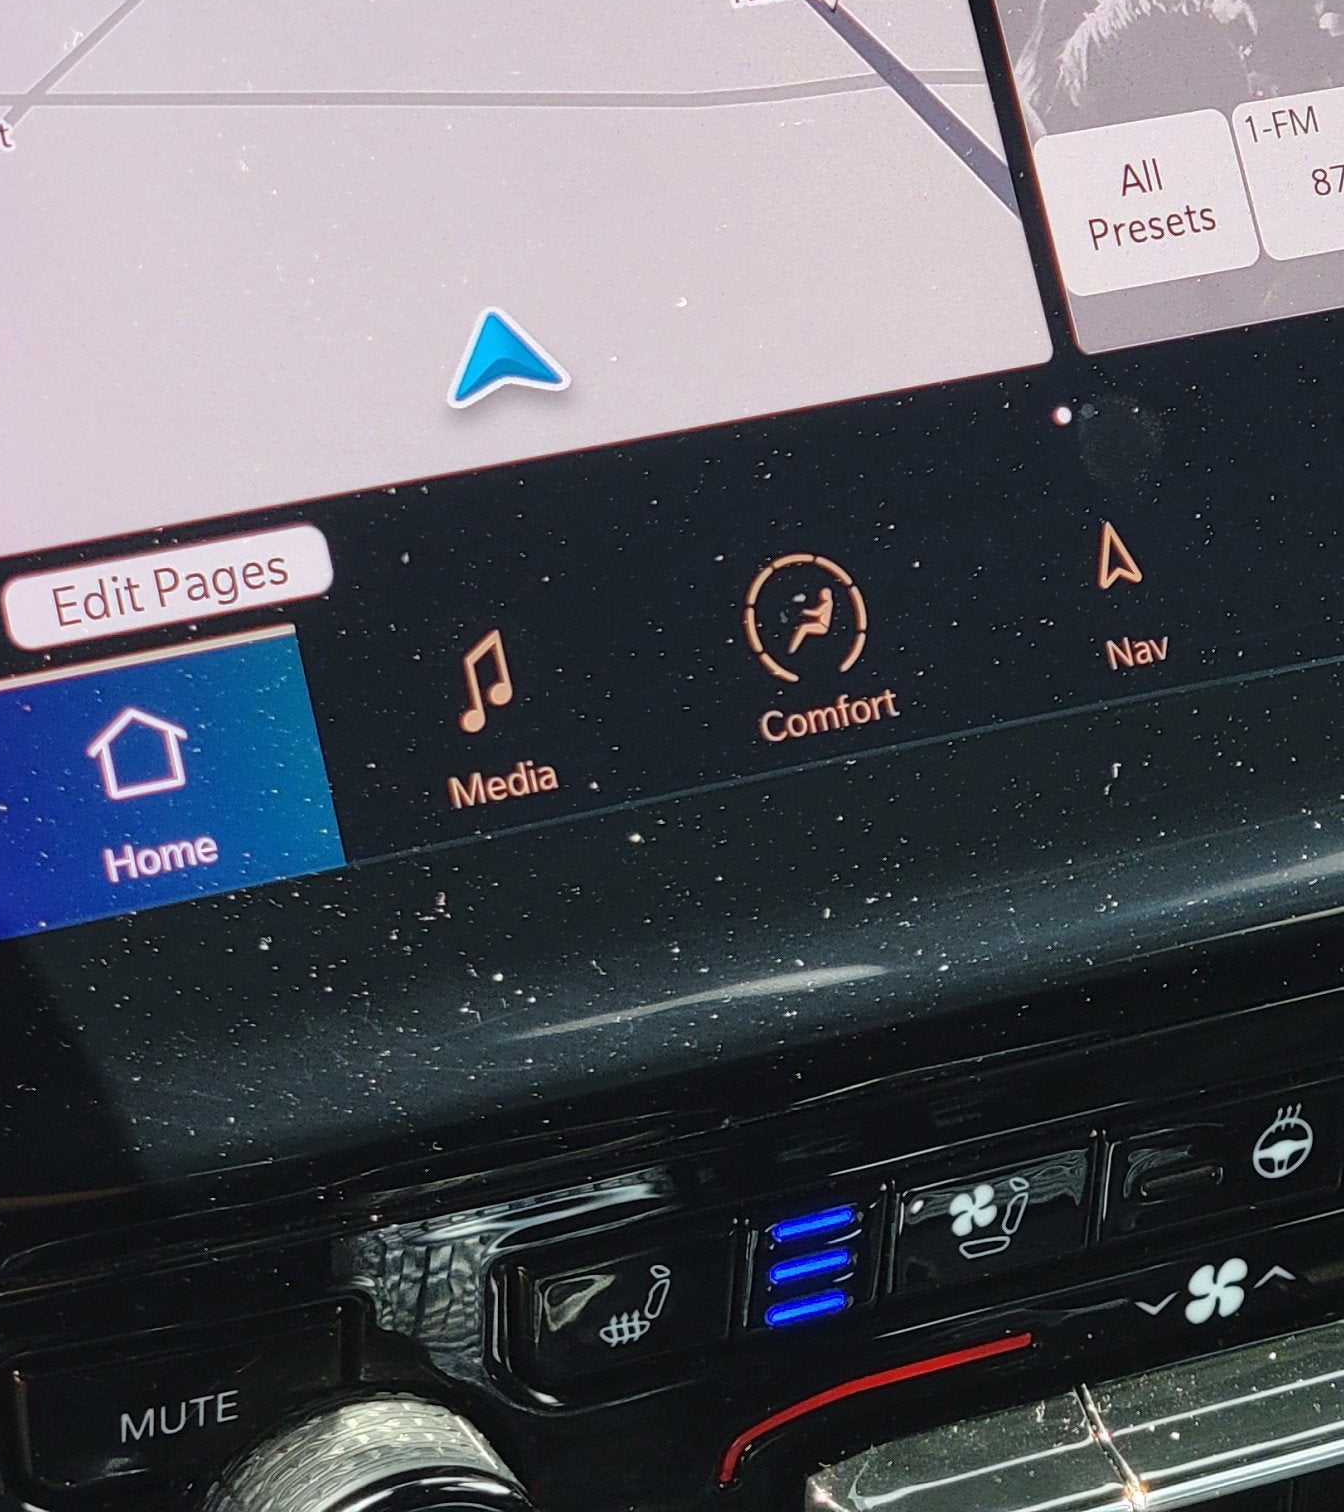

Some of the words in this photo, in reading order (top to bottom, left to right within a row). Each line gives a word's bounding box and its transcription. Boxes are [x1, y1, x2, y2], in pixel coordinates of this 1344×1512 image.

[1244, 105, 1320, 144] 1-FM
[1120, 158, 1165, 197] All
[1088, 203, 1218, 251] Presets
[52, 575, 146, 628] Edit
[153, 552, 290, 610] Pages
[1104, 634, 1170, 671] Nav
[759, 687, 901, 744] Comfort
[448, 759, 560, 811] Media
[102, 834, 220, 884] Home
[119, 1389, 240, 1444] MUTE
